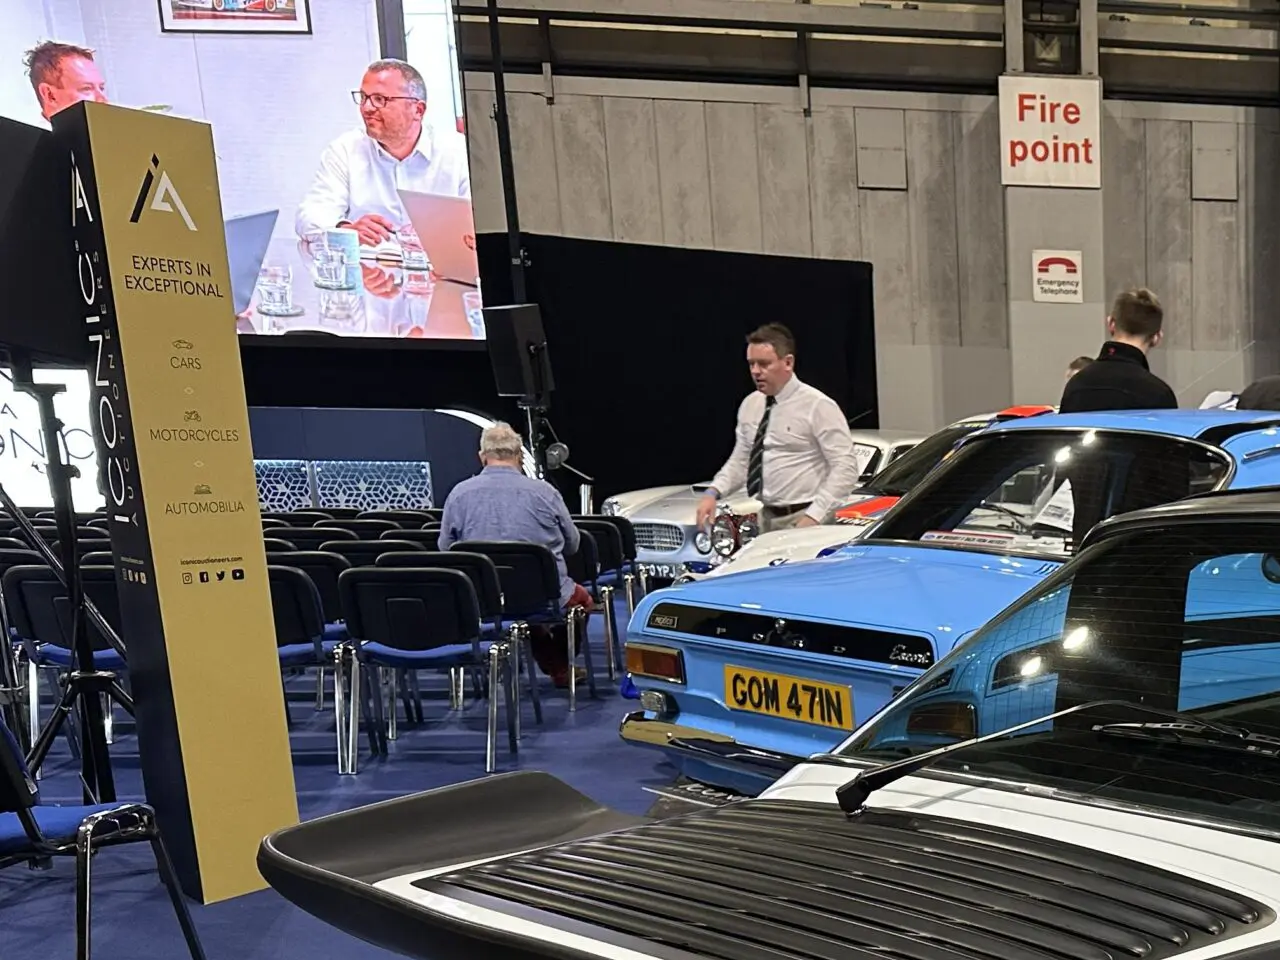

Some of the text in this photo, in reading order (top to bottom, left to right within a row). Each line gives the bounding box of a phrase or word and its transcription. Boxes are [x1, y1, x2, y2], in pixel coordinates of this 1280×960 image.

[1017, 93, 1081, 124] Fire
[1010, 135, 1093, 167] point
[132, 255, 211, 277] EXPERTS IN
[124, 275, 224, 298] EXCEPTIONAL
[1037, 278, 1079, 288] Emergency
[1039, 286, 1078, 295] Telephone
[170, 356, 202, 370] CARS
[79, 252, 129, 522] ICONIC
[149, 428, 239, 442] MOTORCYCLES
[165, 500, 245, 515] AUTOMOBILIA
[731, 672, 780, 714] GOM
